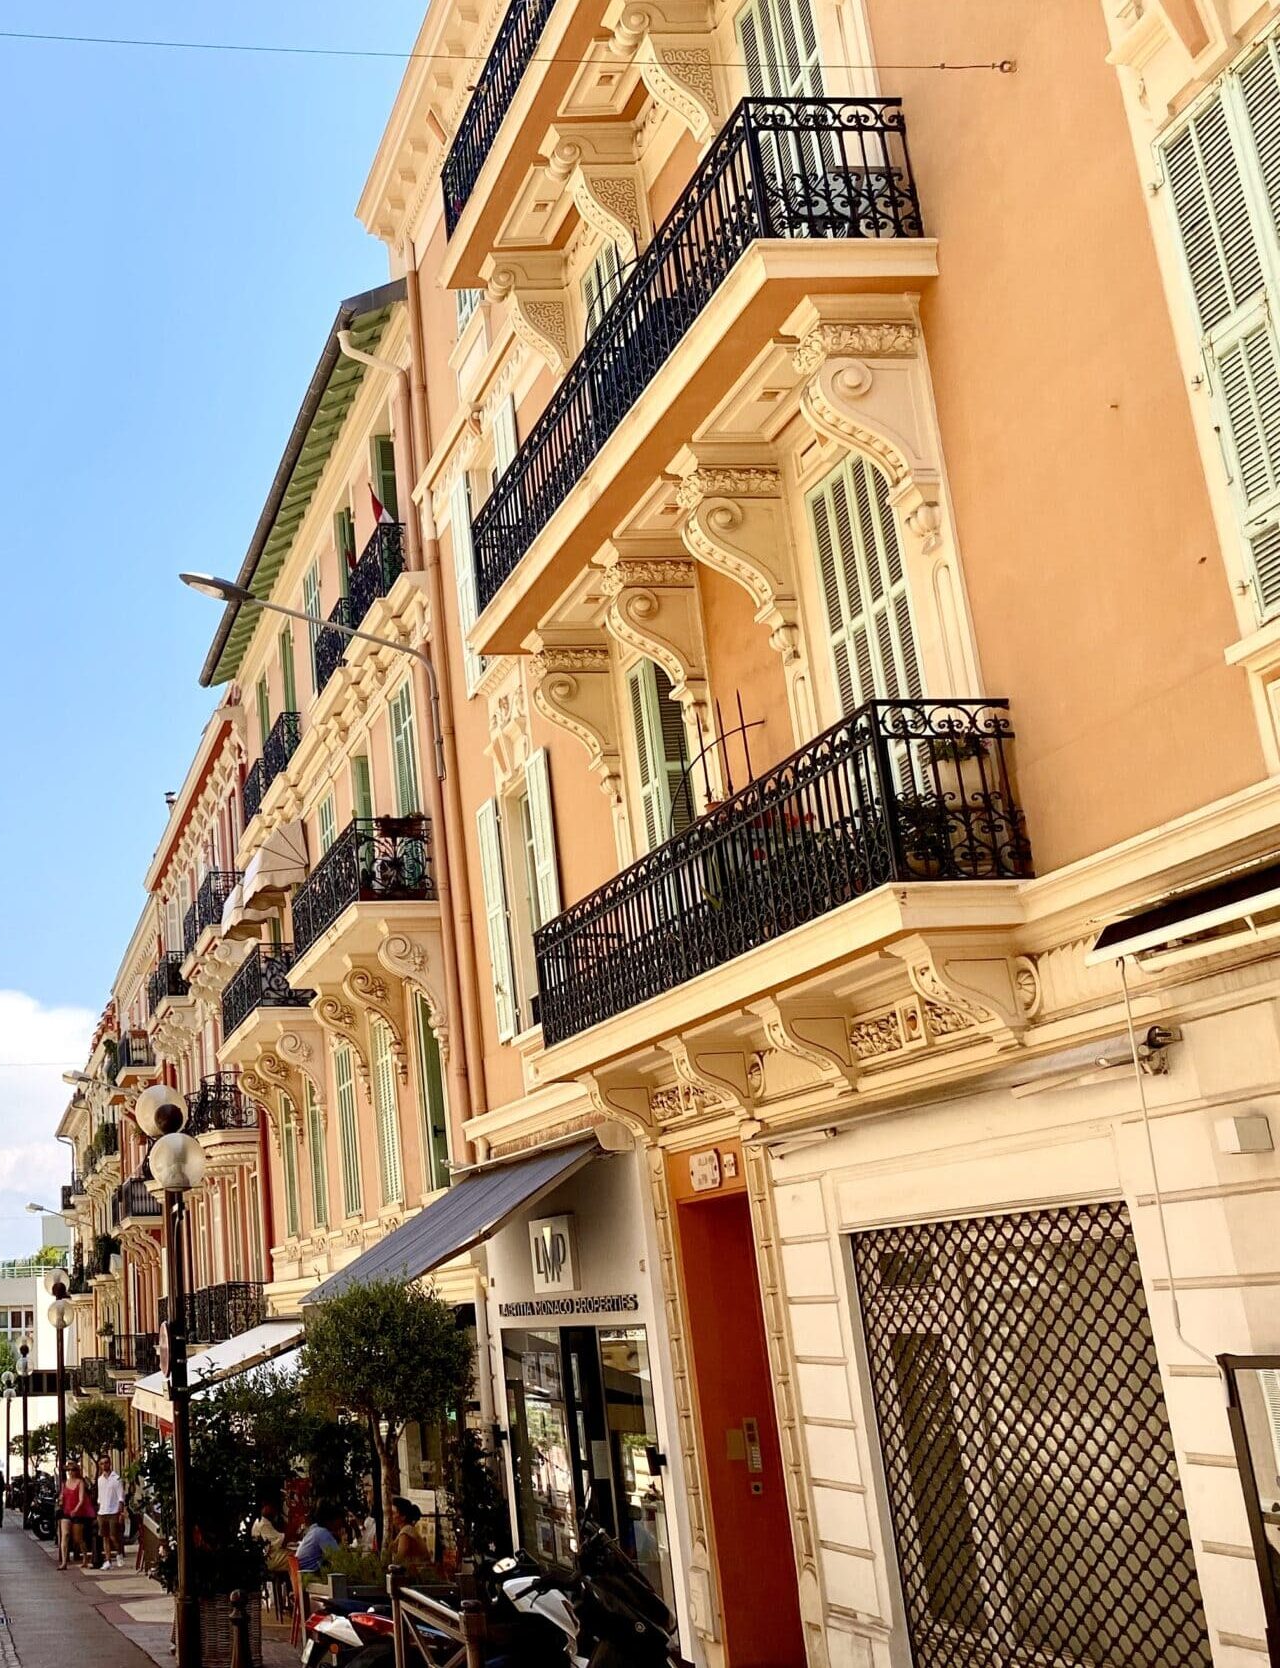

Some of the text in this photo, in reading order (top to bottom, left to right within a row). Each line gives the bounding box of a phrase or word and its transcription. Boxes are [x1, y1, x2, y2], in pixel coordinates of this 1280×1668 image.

[534, 1227, 567, 1284] LMP
[535, 1298, 575, 1316] MONACO
[576, 1293, 639, 1314] PROPERTIES
